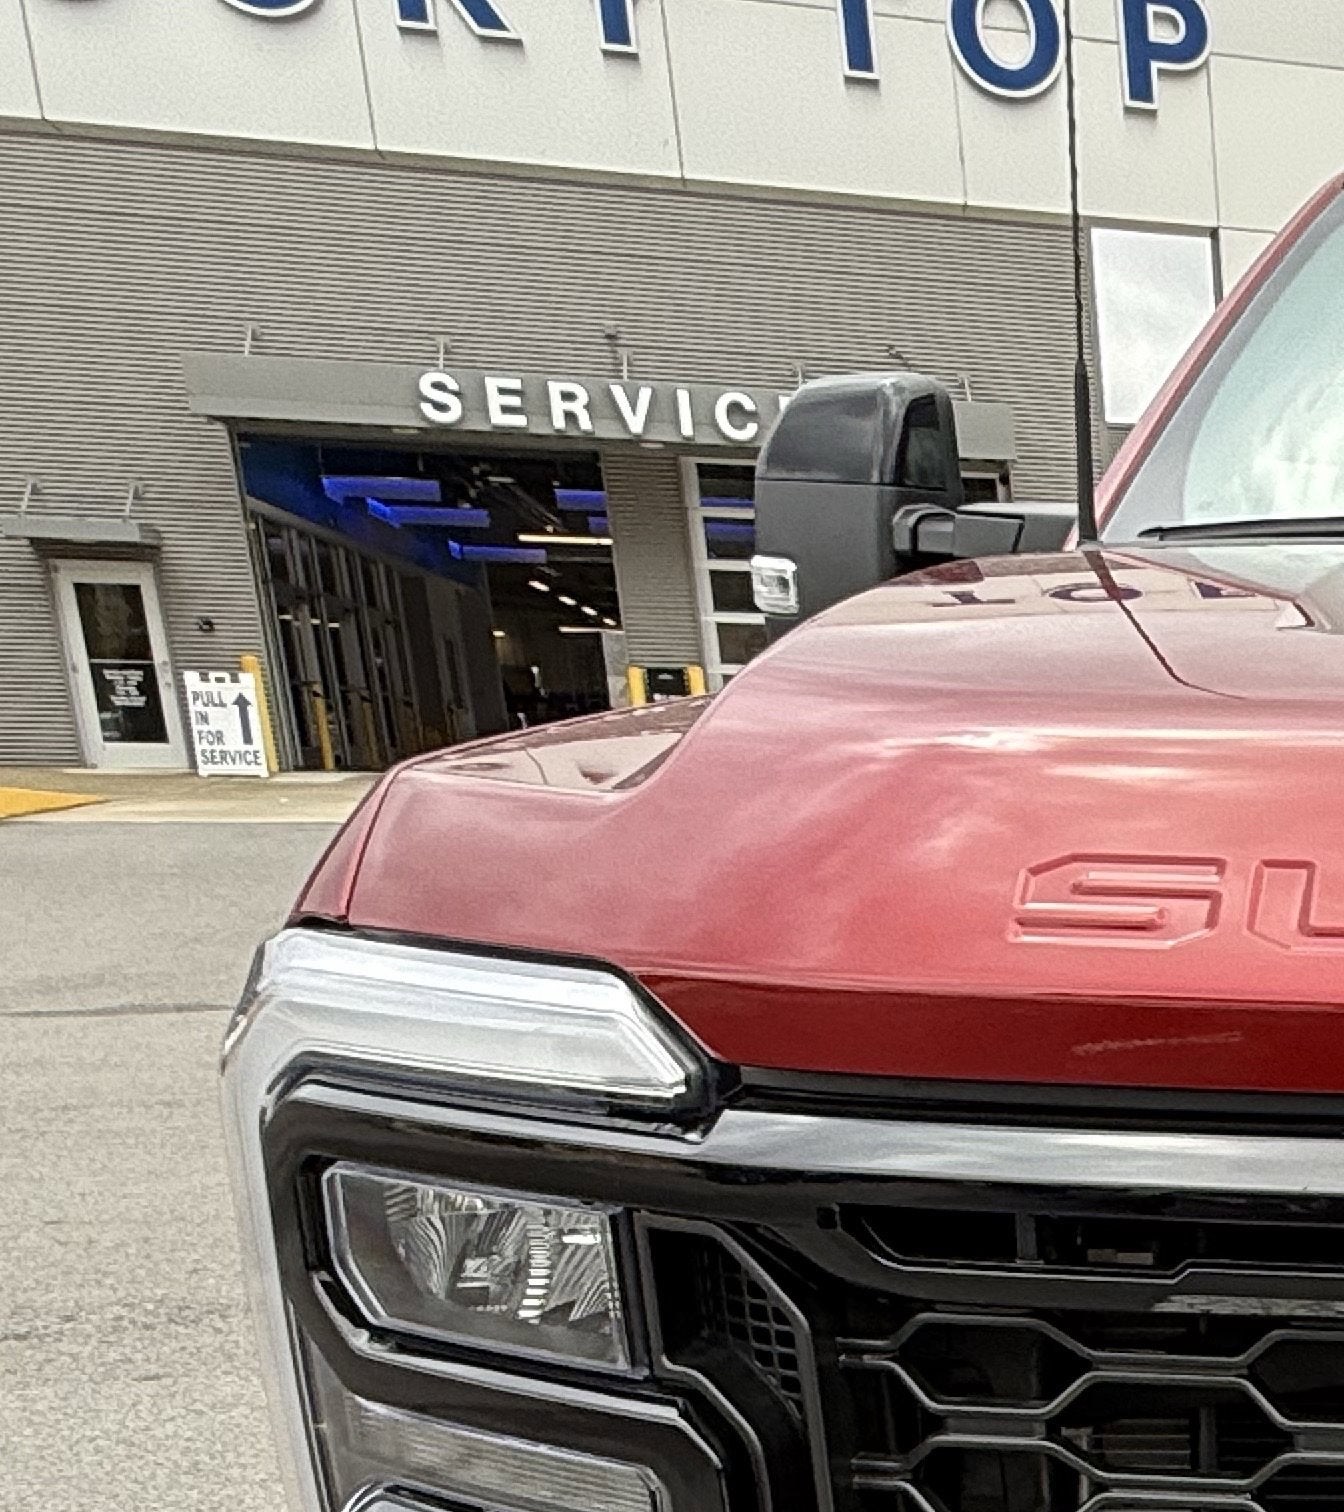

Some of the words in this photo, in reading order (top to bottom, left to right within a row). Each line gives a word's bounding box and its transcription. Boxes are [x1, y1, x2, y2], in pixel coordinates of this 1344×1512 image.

[418, 372, 794, 442] SERVIC
[191, 690, 228, 708] PULL
[195, 711, 211, 726] IN
[197, 730, 226, 746] FOR
[200, 750, 263, 767] SERVICE
